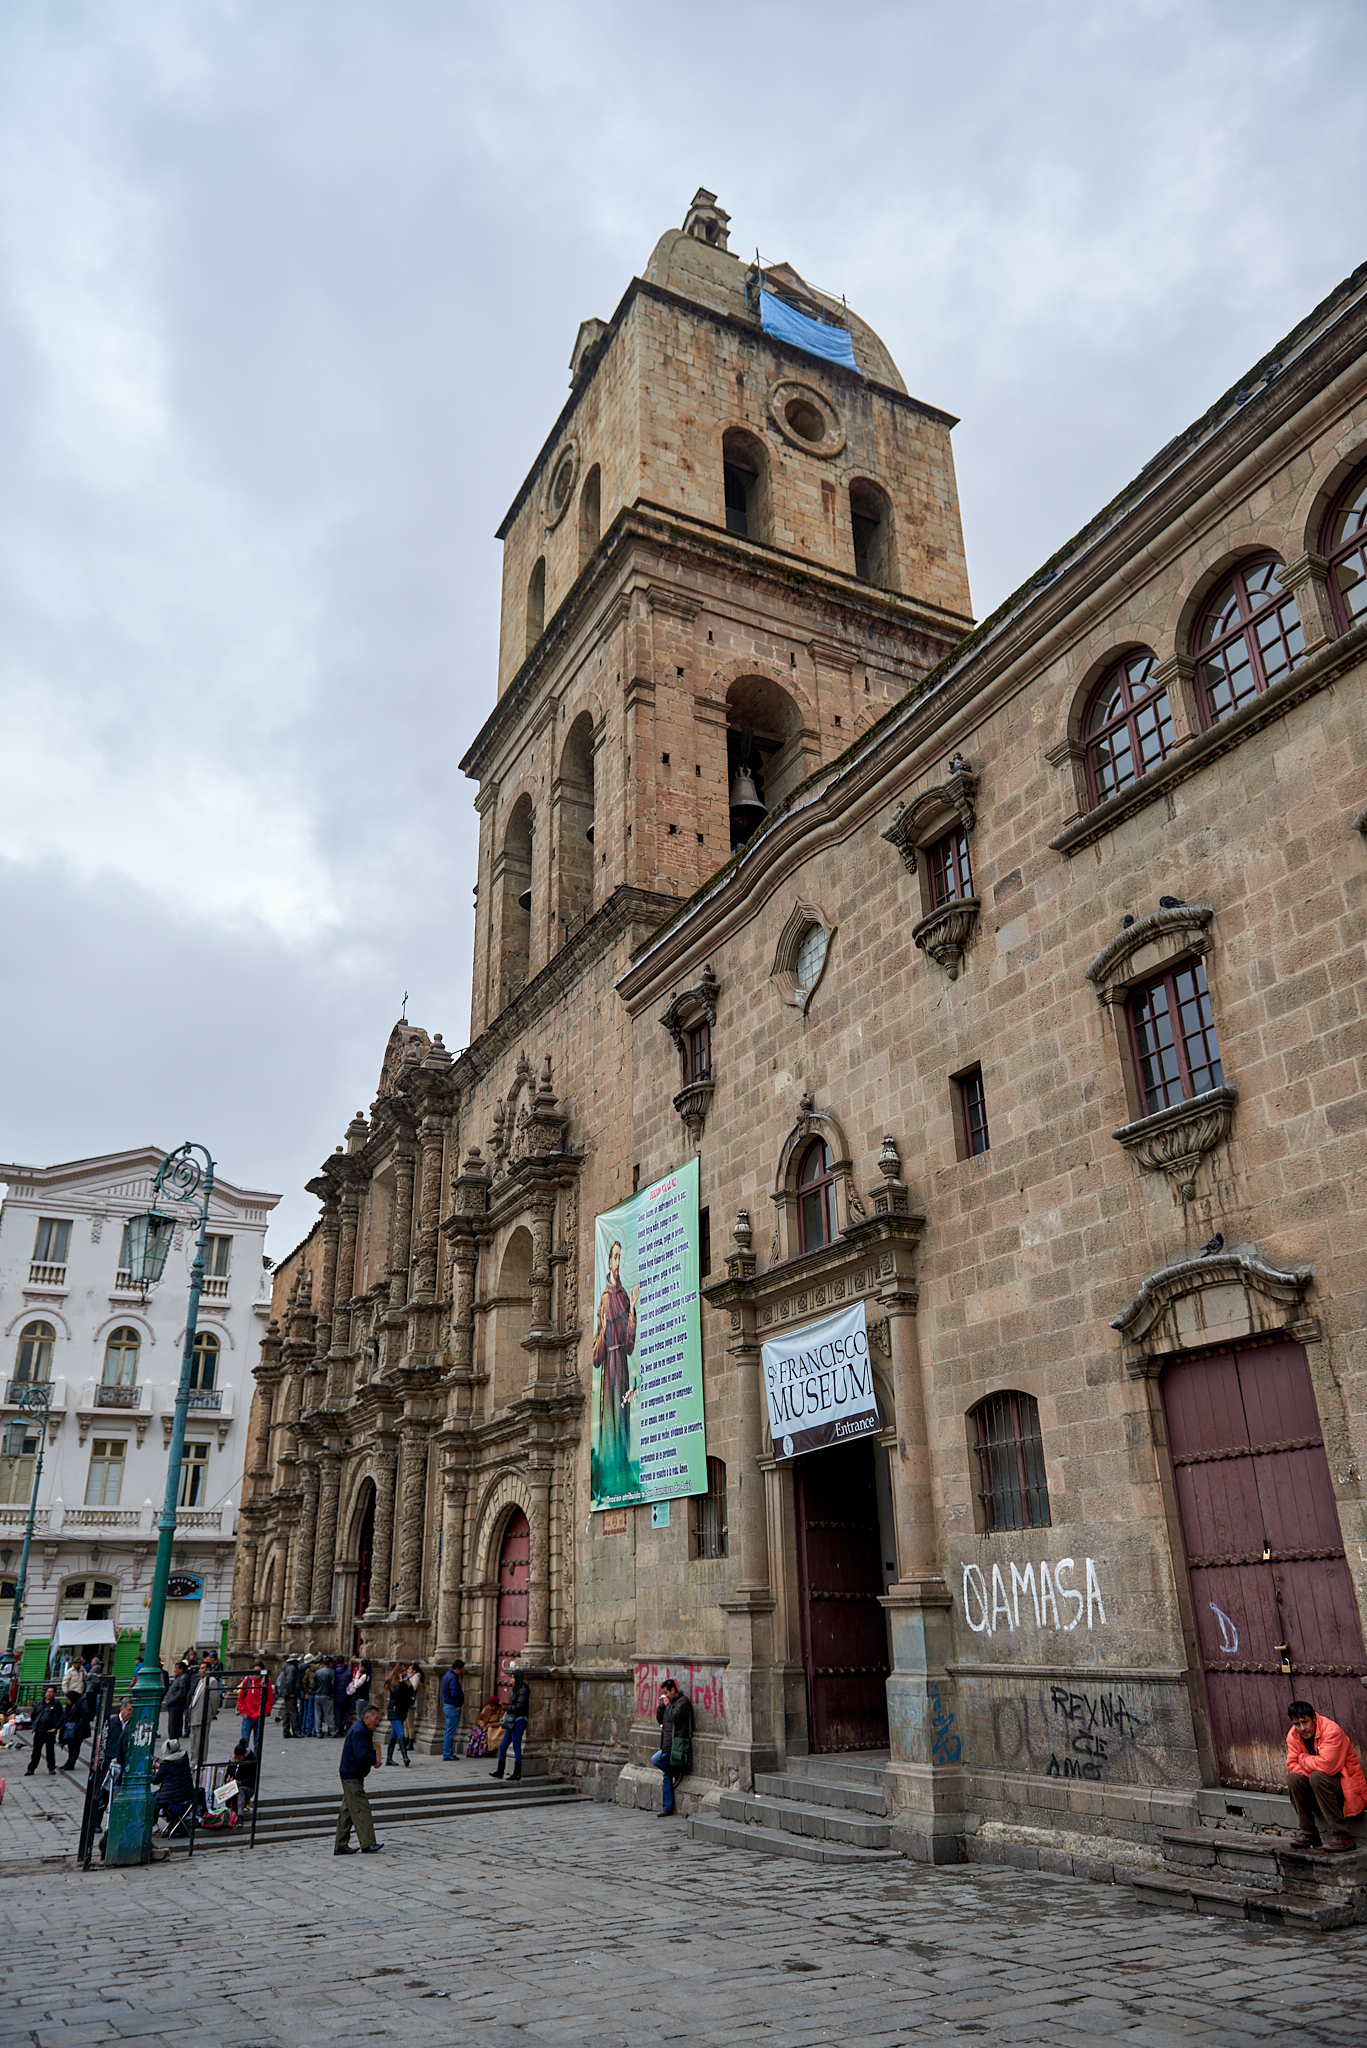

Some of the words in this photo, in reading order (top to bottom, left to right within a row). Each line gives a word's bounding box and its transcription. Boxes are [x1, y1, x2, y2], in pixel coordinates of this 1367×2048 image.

[779, 1330, 867, 1384] FRANCISCO
[770, 1358, 874, 1426] MUSEUM
[835, 1416, 875, 1437] Entrance
[961, 1557, 1107, 1638] QAMASA
